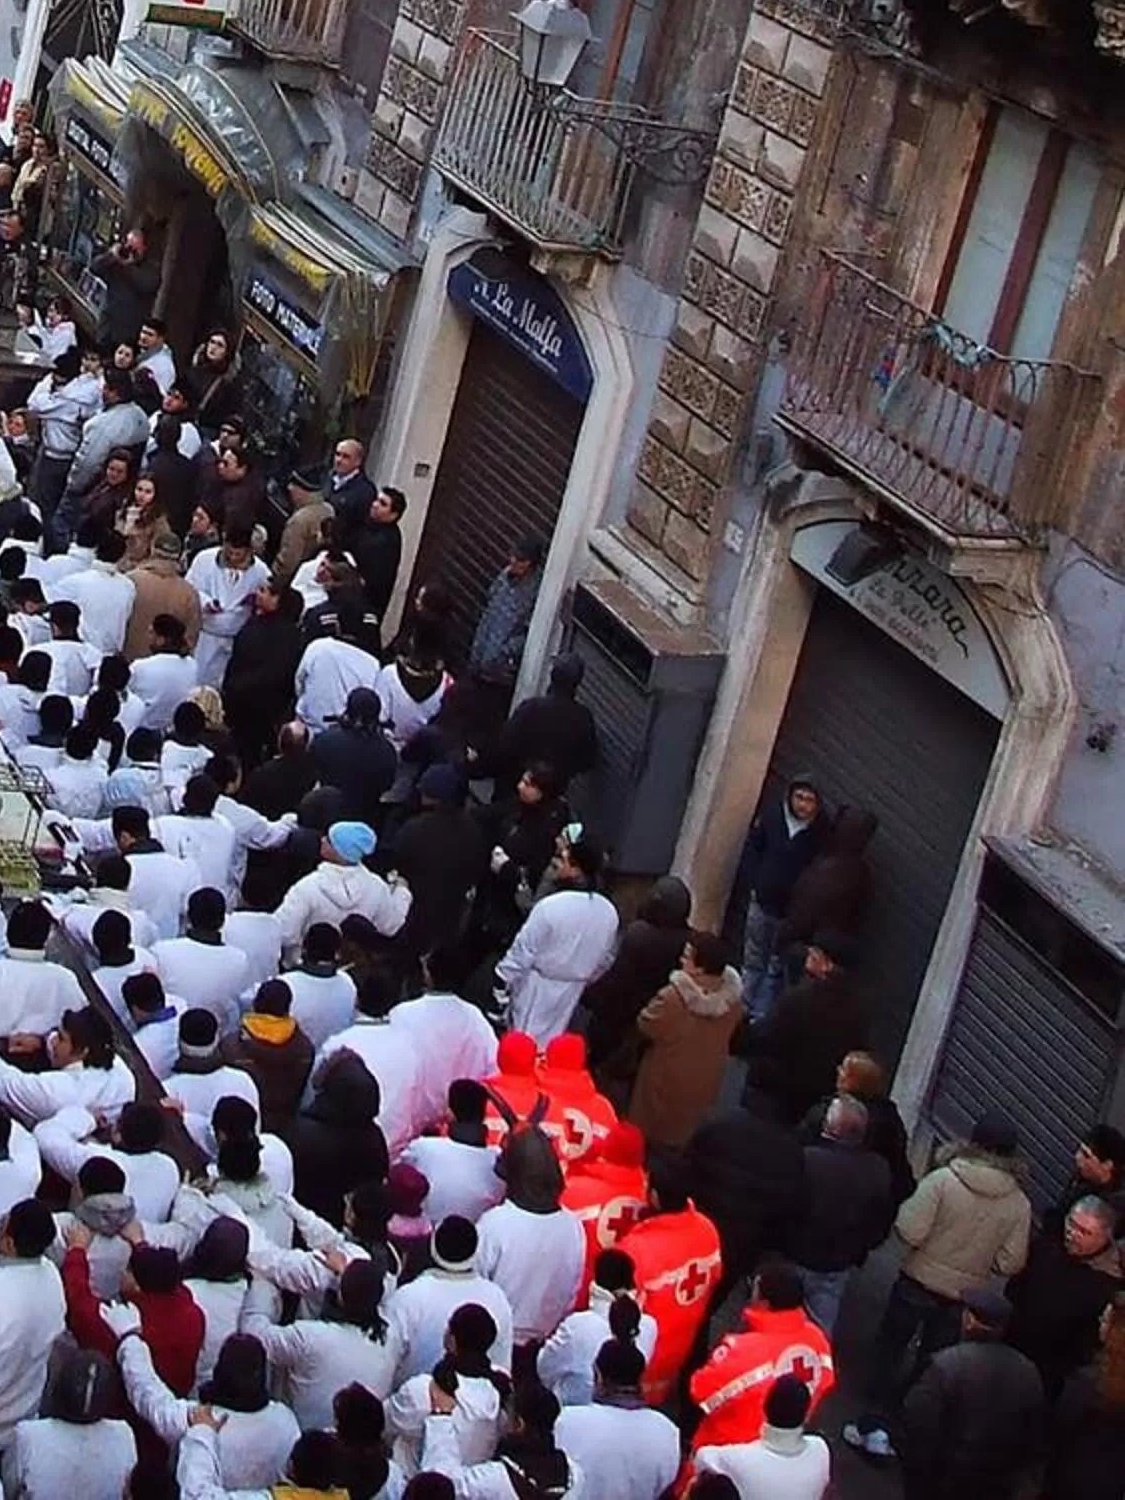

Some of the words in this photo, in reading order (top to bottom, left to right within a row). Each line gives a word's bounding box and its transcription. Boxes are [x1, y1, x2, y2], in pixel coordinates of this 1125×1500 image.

[250, 280, 275, 313] FOTO
[491, 283, 515, 318] La
[512, 298, 564, 358] Malfa
